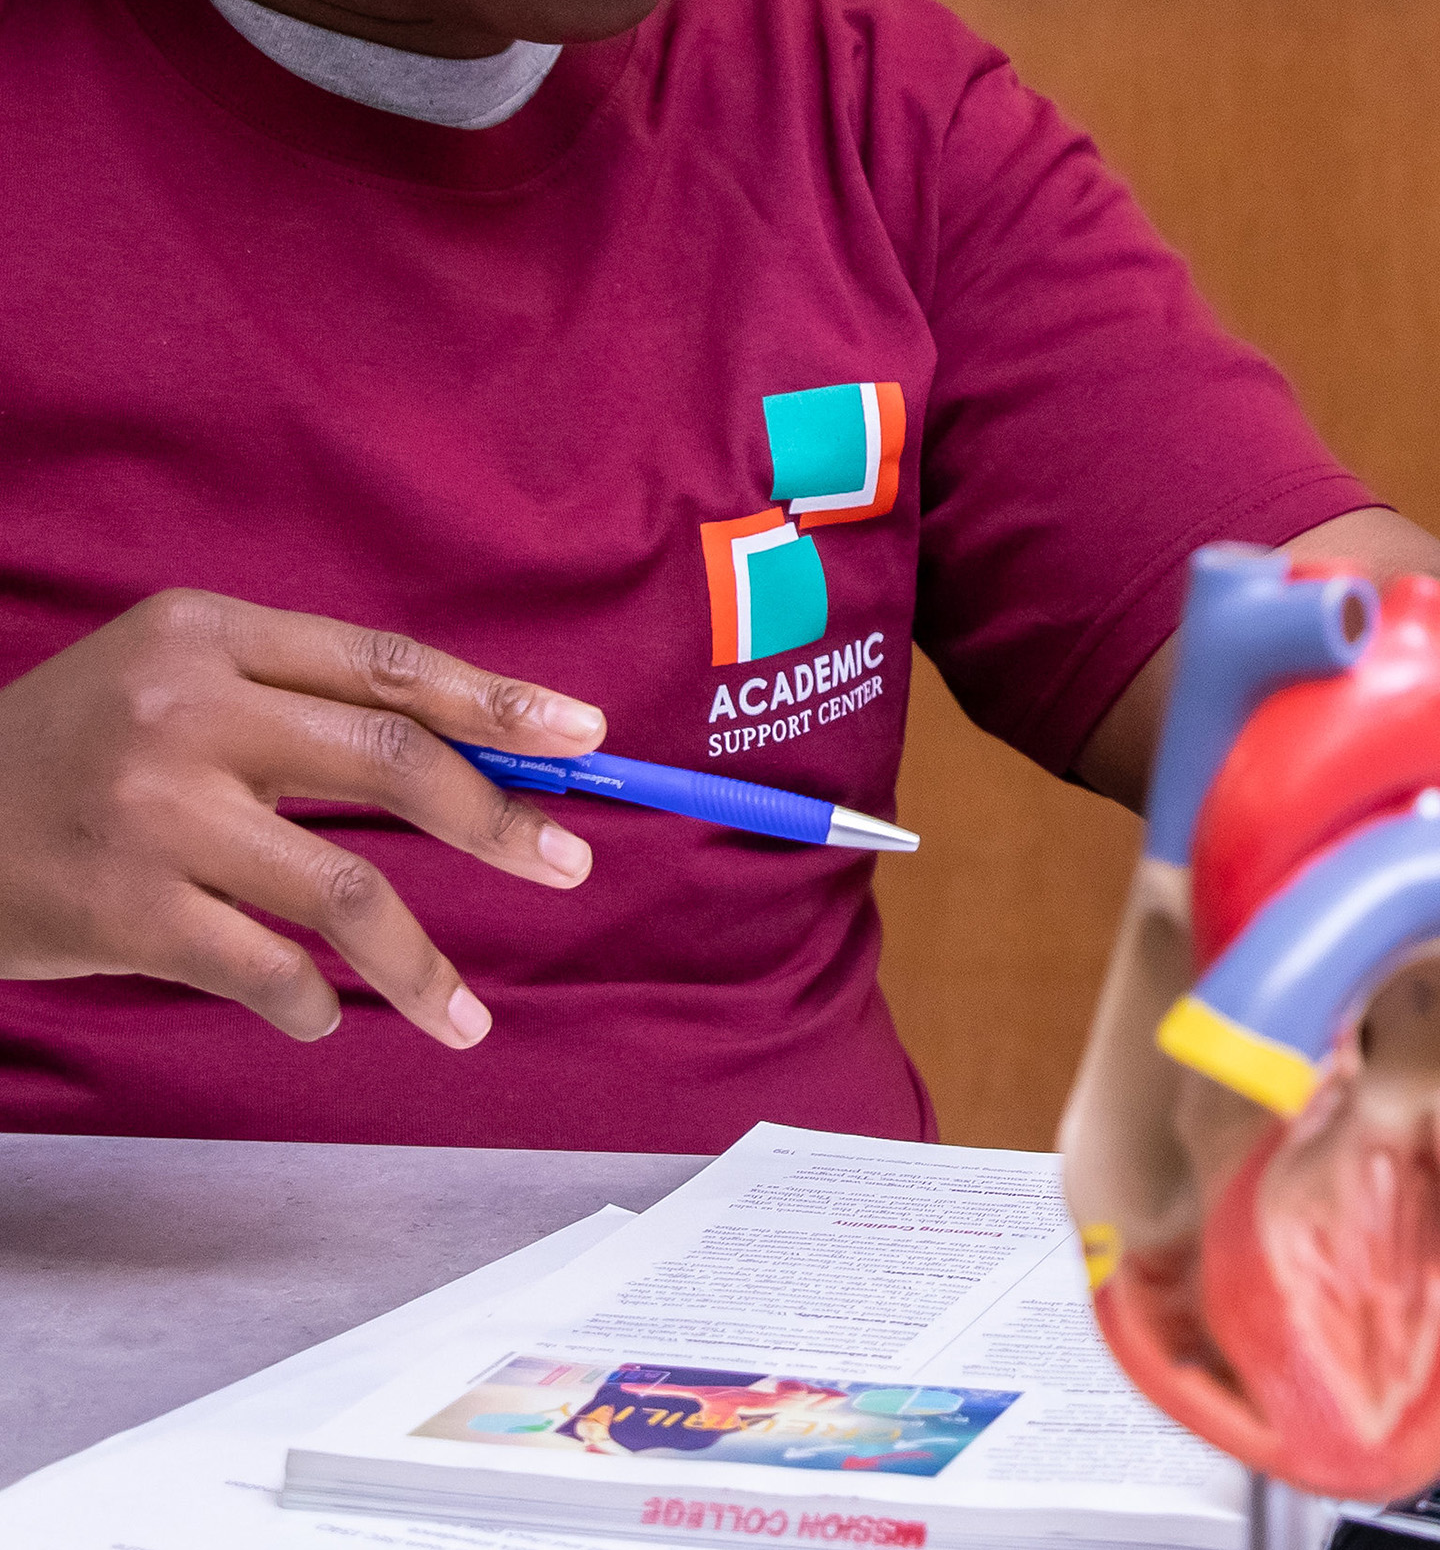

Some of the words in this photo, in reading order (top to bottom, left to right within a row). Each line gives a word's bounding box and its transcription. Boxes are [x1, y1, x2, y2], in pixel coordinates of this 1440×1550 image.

[708, 631, 885, 723] ACADEMIC
[708, 708, 812, 758] SUPPORT
[818, 674, 884, 725] CENTER
[479, 752, 518, 771] Center
[519, 759, 566, 778] Support
[570, 769, 625, 790] Academic
[771, 1147, 796, 1156] 199
[831, 1218, 914, 1232] Credibility
[918, 1225, 1003, 1238] Enhancing
[642, 1495, 789, 1537] COLLEGE
